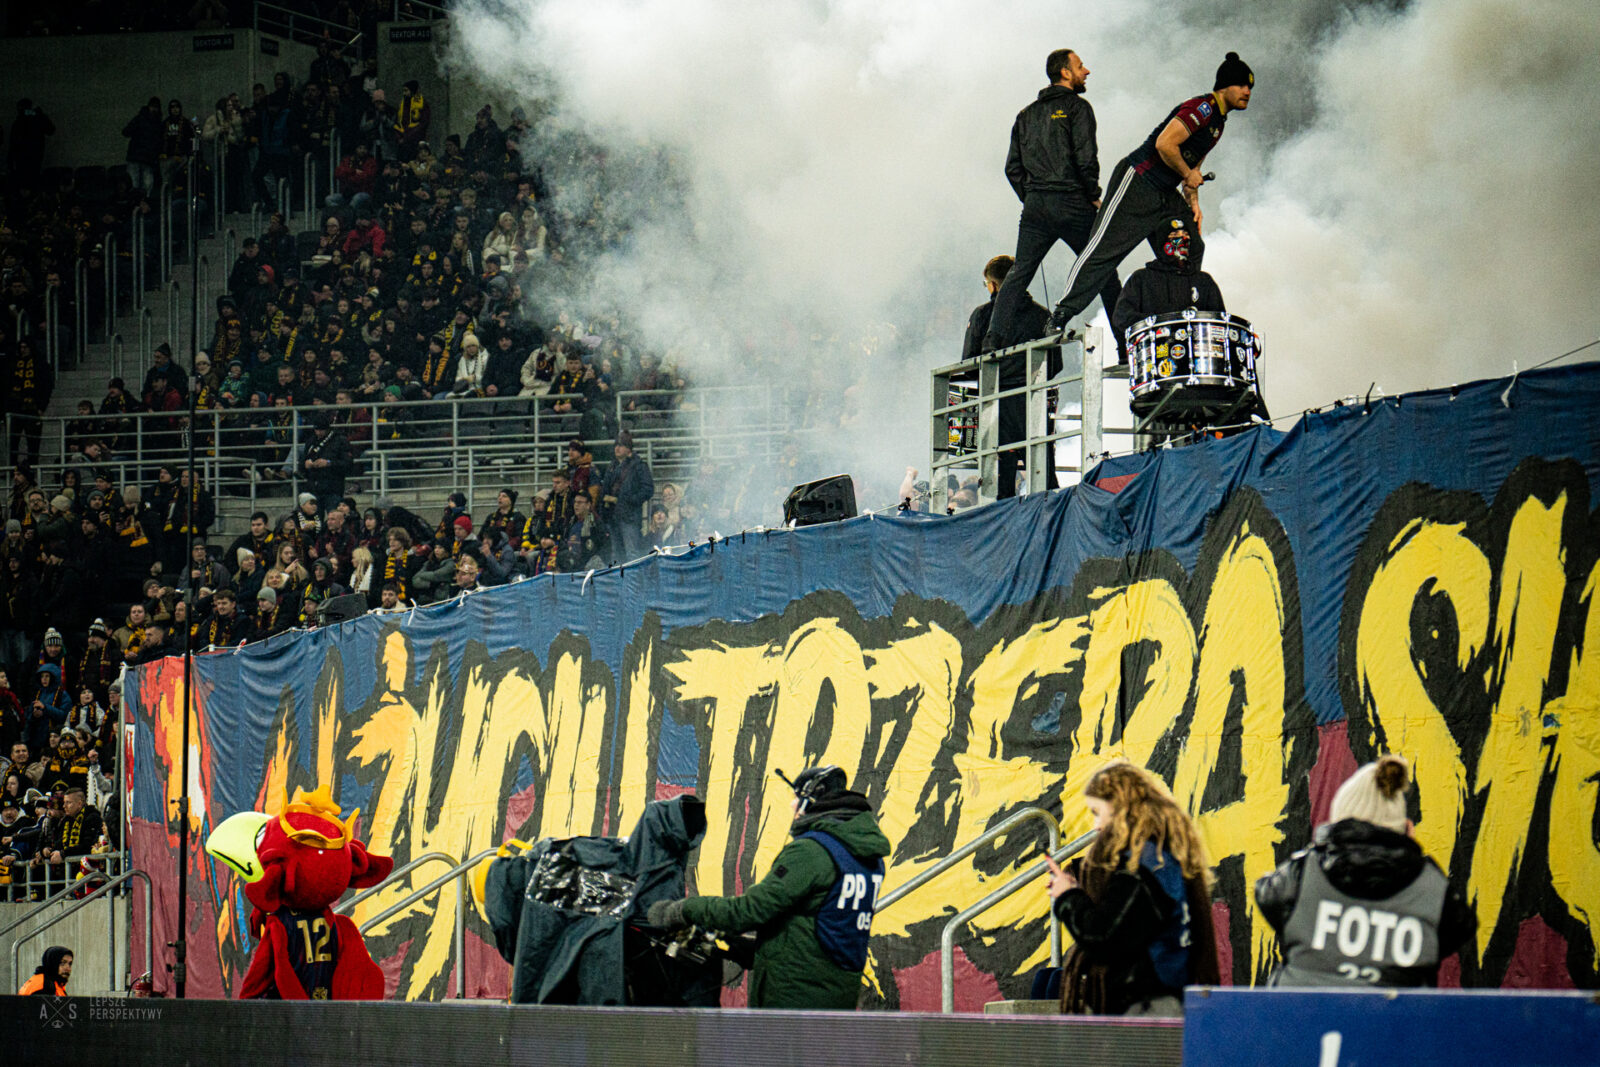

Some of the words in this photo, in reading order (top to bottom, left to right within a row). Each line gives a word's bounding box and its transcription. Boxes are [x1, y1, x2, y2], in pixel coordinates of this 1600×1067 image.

[837, 873, 867, 911] PP
[297, 917, 332, 964] 12
[856, 911, 872, 931] 05
[1311, 899, 1423, 968] FOTO
